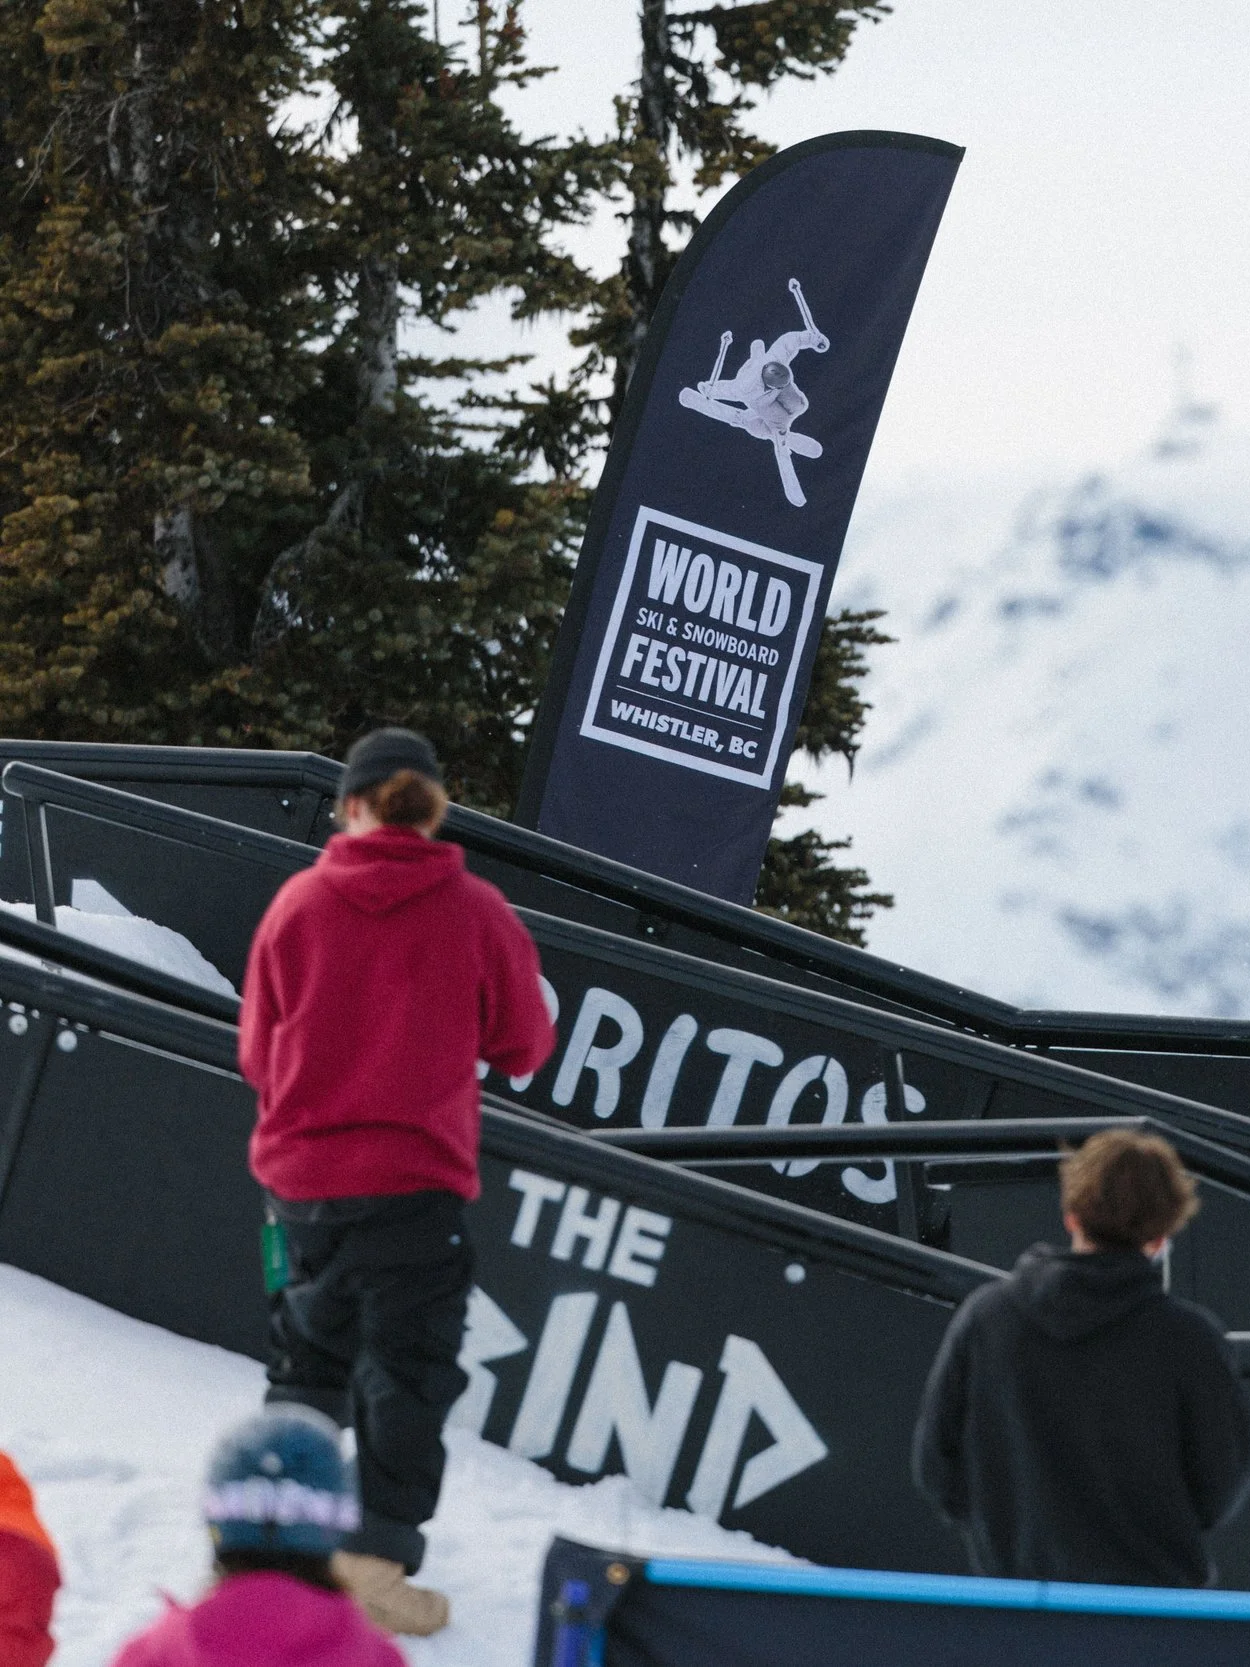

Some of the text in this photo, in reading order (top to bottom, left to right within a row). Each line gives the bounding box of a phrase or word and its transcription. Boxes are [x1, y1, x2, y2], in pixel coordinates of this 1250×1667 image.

[648, 538, 792, 637] WORLD
[620, 632, 767, 720] FESTIVAL
[636, 607, 779, 667] SKI & SNOWBOARD
[611, 699, 758, 759] WHISTLER, BC
[475, 973, 926, 1204] RITOS
[509, 1169, 673, 1287] THE
